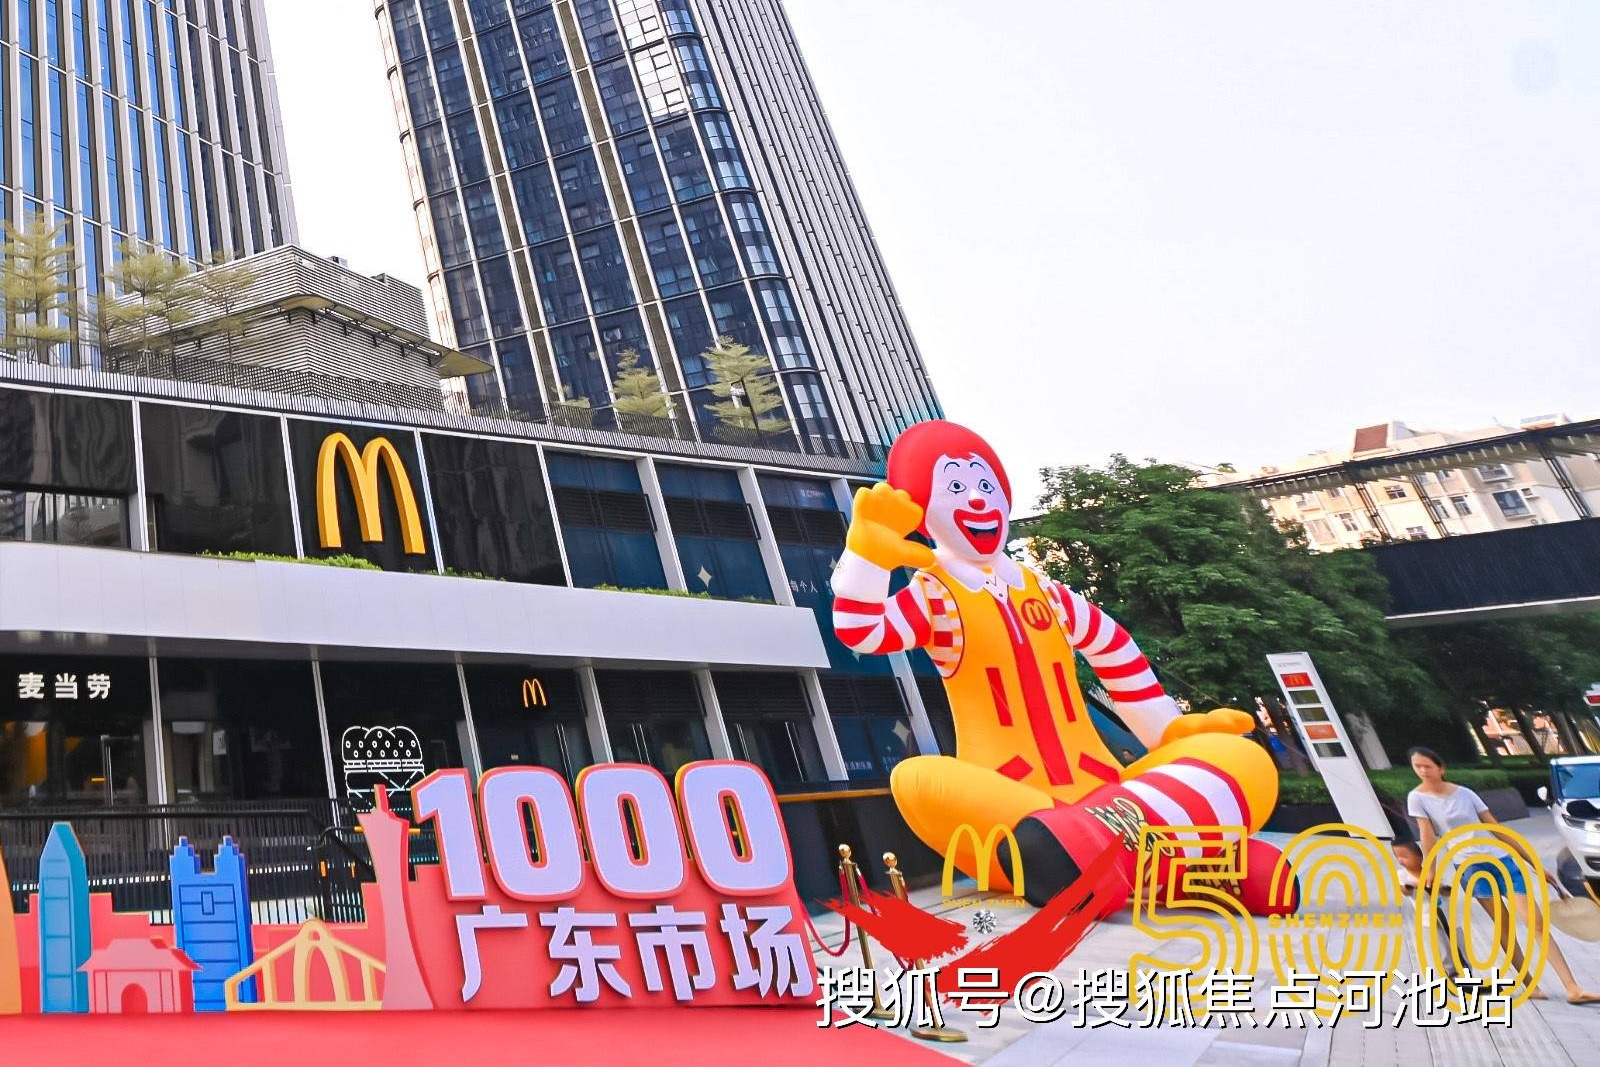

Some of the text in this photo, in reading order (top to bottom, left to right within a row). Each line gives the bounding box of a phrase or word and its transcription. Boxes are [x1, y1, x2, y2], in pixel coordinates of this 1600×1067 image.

[18, 672, 111, 700] 麦当劳
[410, 759, 794, 902] 1000
[455, 902, 813, 1004] 广东市场
